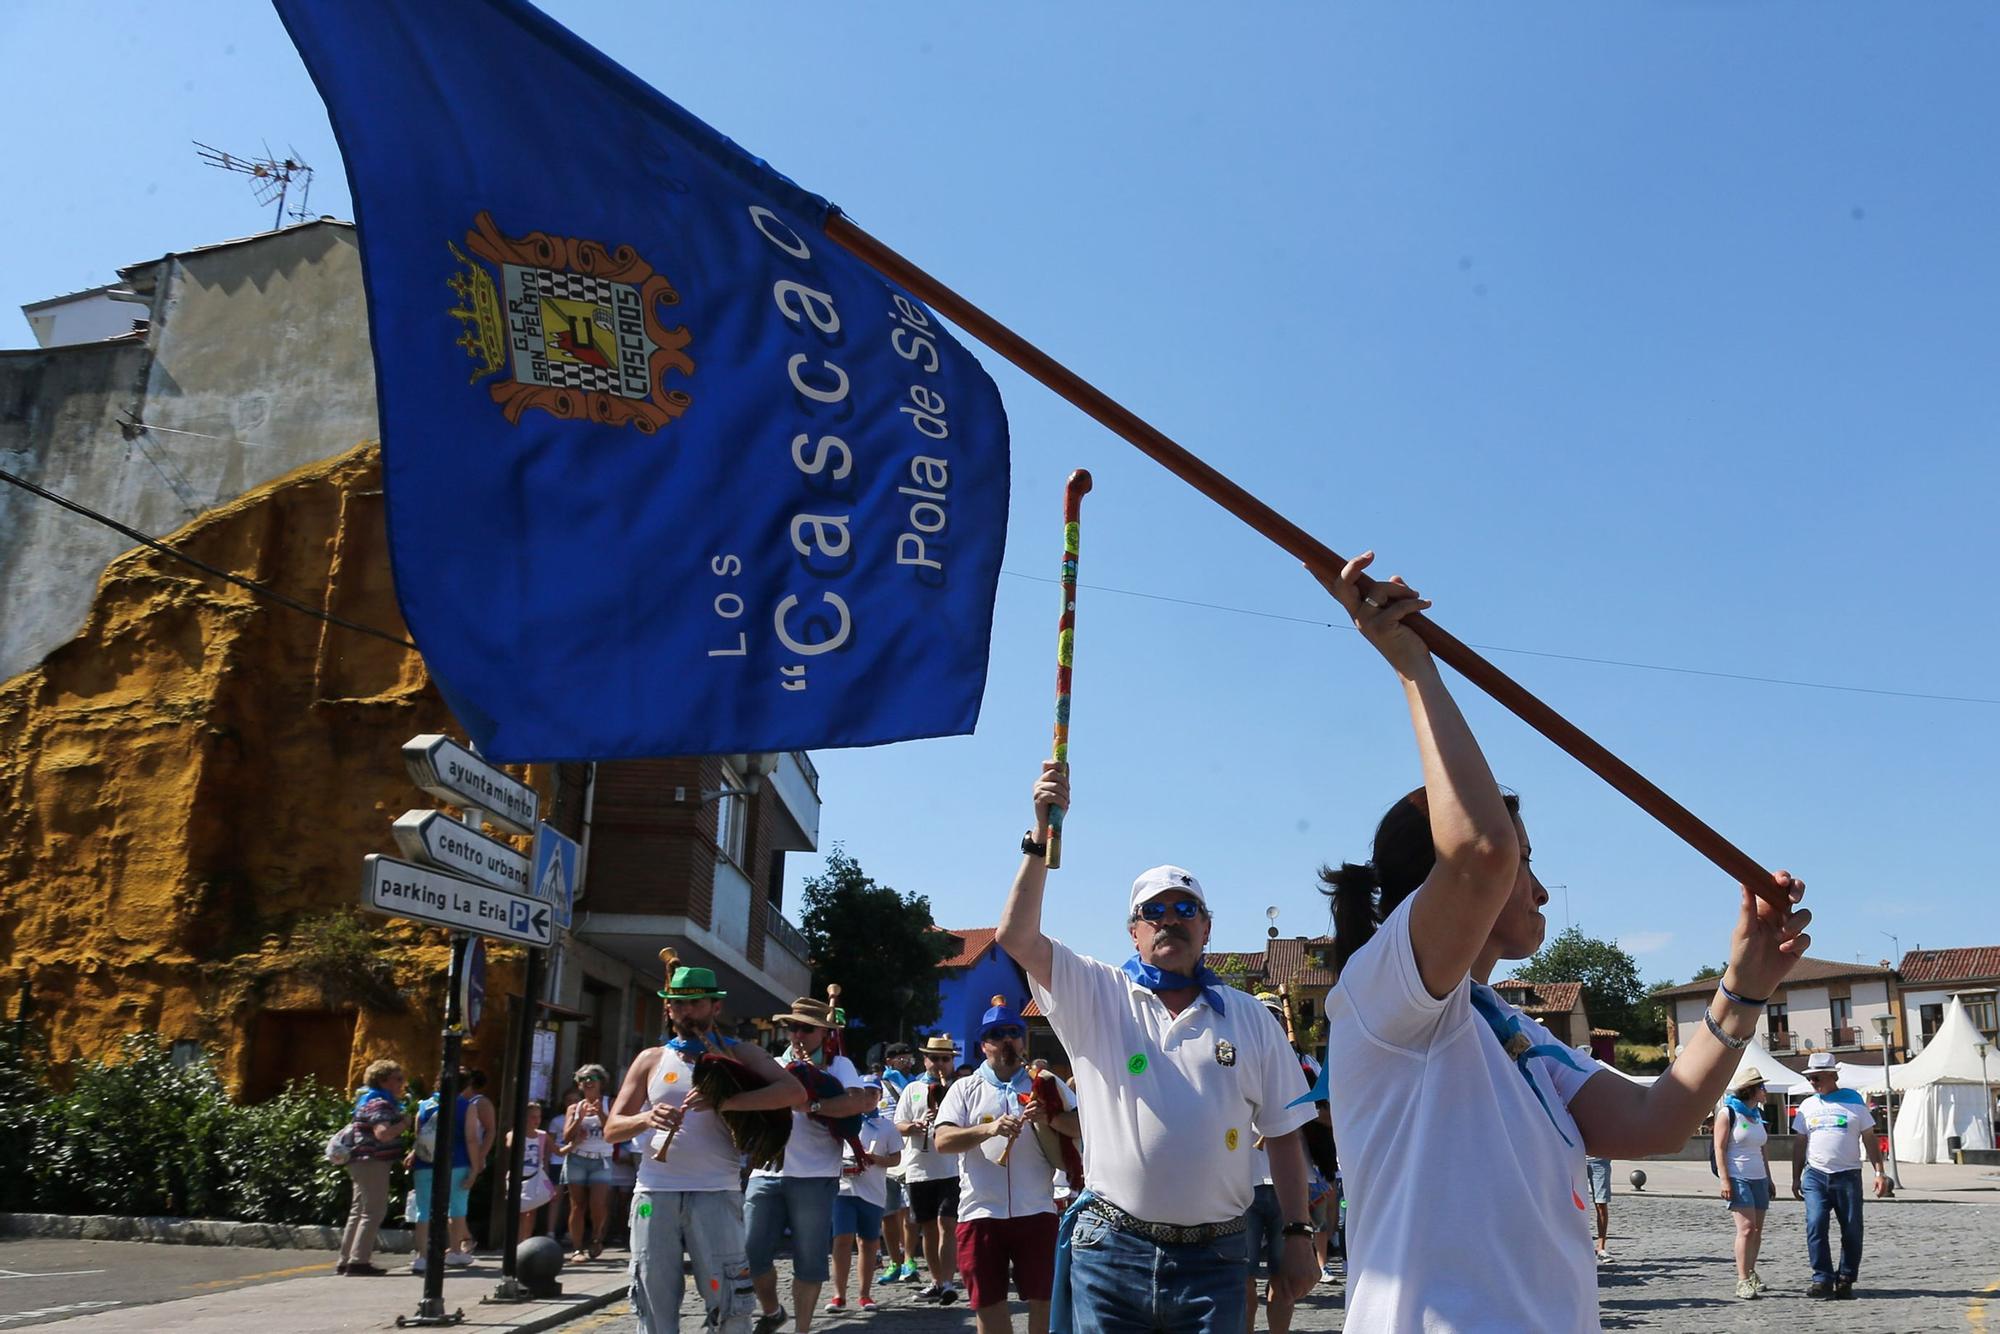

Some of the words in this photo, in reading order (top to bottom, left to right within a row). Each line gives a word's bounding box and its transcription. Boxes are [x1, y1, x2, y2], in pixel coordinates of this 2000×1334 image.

[509, 297, 529, 351] G.C.R.
[520, 271, 543, 338] PELAYO
[888, 286, 939, 373] Sie
[531, 350, 549, 382] SAN
[615, 288, 648, 395] CASCAOS
[900, 384, 949, 440] de
[896, 455, 948, 570] Pola
[708, 553, 748, 657] Los
[449, 760, 534, 819] ayuntamiento
[439, 833, 484, 865] centro
[487, 856, 529, 885] urbano
[381, 878, 447, 911] parking
[453, 893, 471, 914] La
[479, 902, 508, 923] Eria
